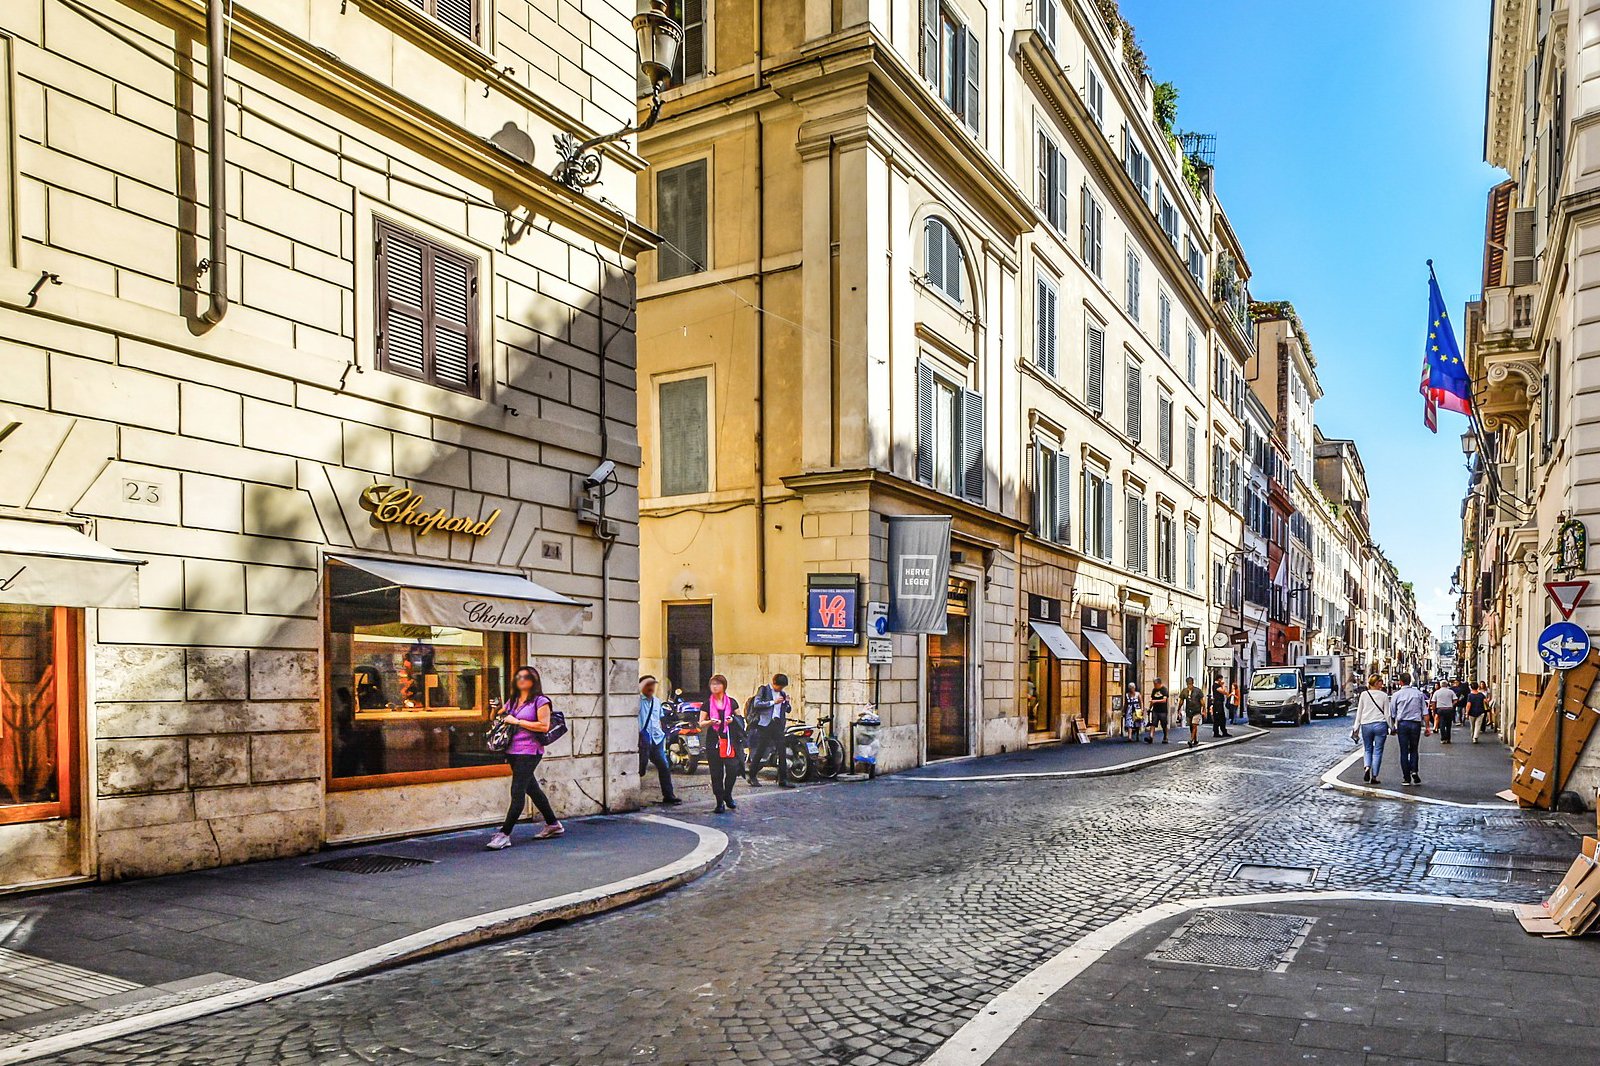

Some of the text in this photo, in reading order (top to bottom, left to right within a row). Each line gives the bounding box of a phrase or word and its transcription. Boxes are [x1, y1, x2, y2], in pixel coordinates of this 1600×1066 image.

[126, 482, 160, 503] 23
[365, 483, 502, 537] Chopard
[904, 578, 929, 586] LEGER
[905, 568, 930, 576] HERVE
[463, 600, 535, 628] Chopard
